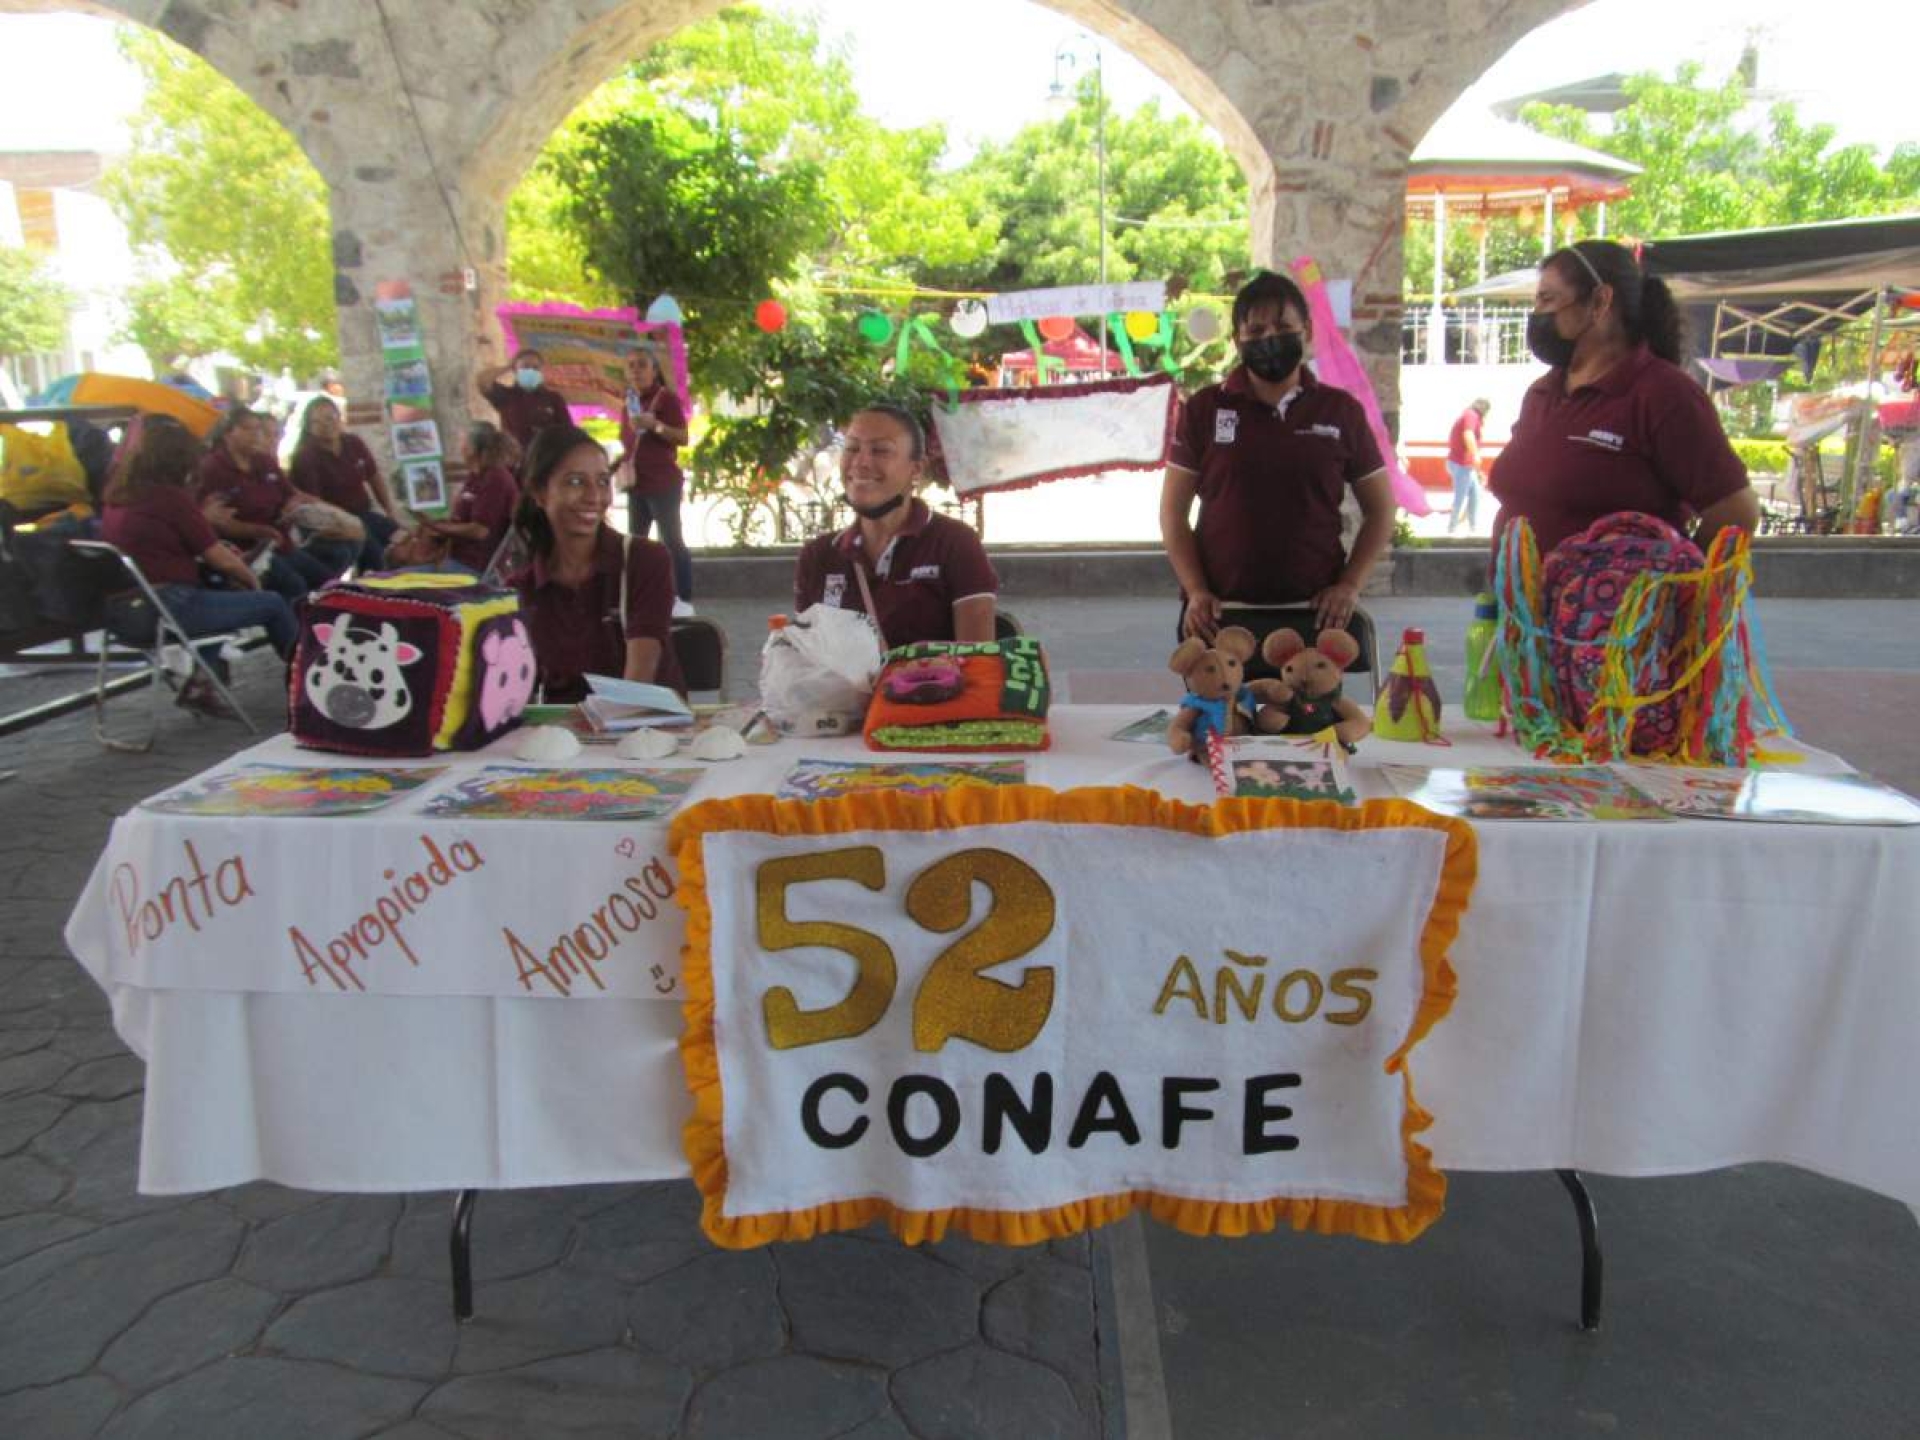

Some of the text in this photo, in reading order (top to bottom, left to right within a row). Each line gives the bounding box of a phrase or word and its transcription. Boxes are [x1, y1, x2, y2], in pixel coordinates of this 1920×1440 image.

[288, 834, 486, 992] Apropiada
[502, 856, 677, 998] Amorosa
[756, 845, 1379, 1053] 52 AÑOS
[801, 1071, 1301, 1157] CONAFE
